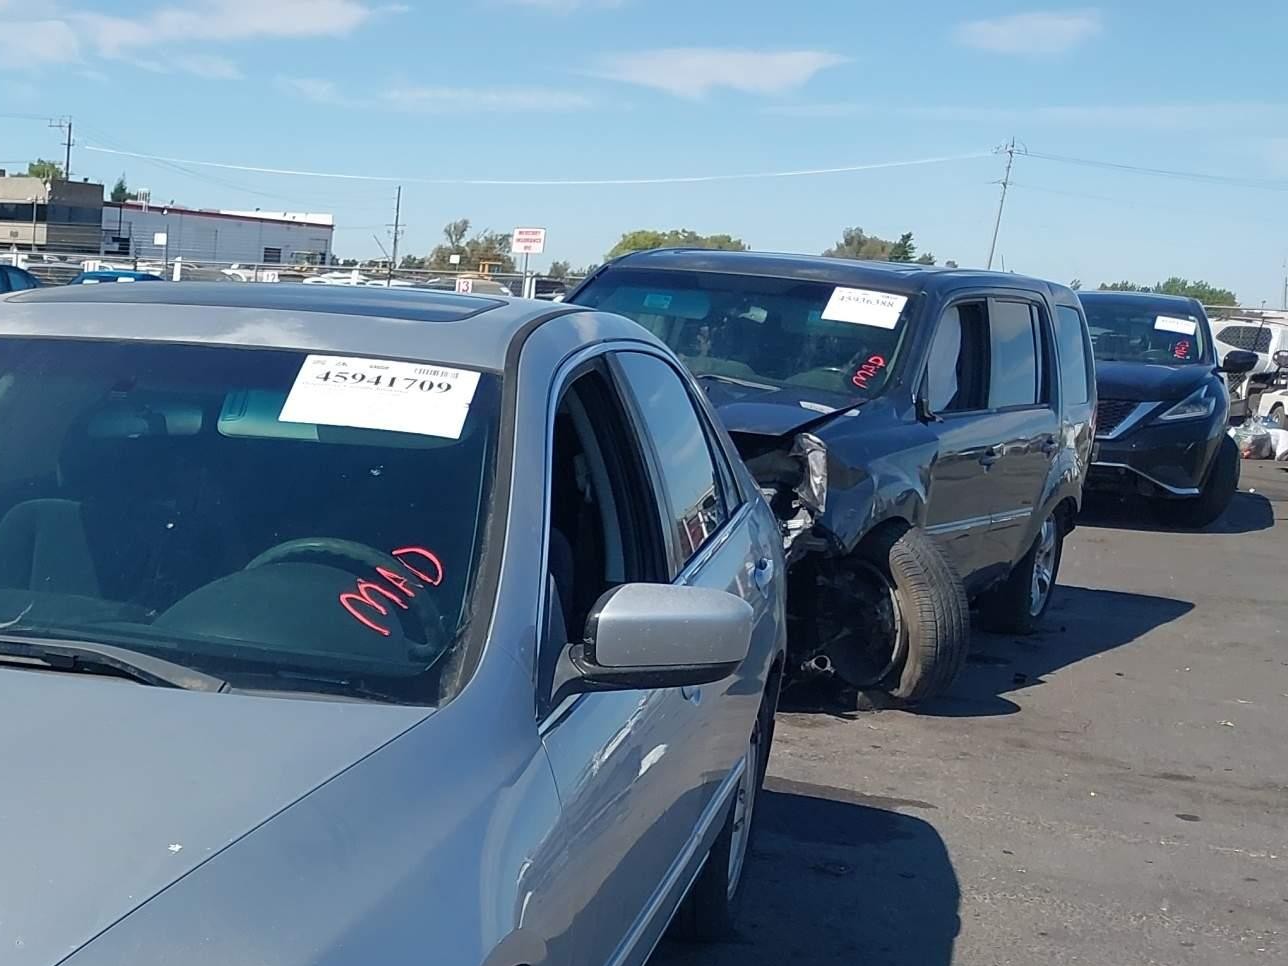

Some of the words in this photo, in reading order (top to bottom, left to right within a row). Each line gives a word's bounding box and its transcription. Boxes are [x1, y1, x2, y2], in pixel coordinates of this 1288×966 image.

[458, 280, 470, 292] 13
[315, 370, 453, 394] 45941709
[339, 546, 446, 637] MAD
